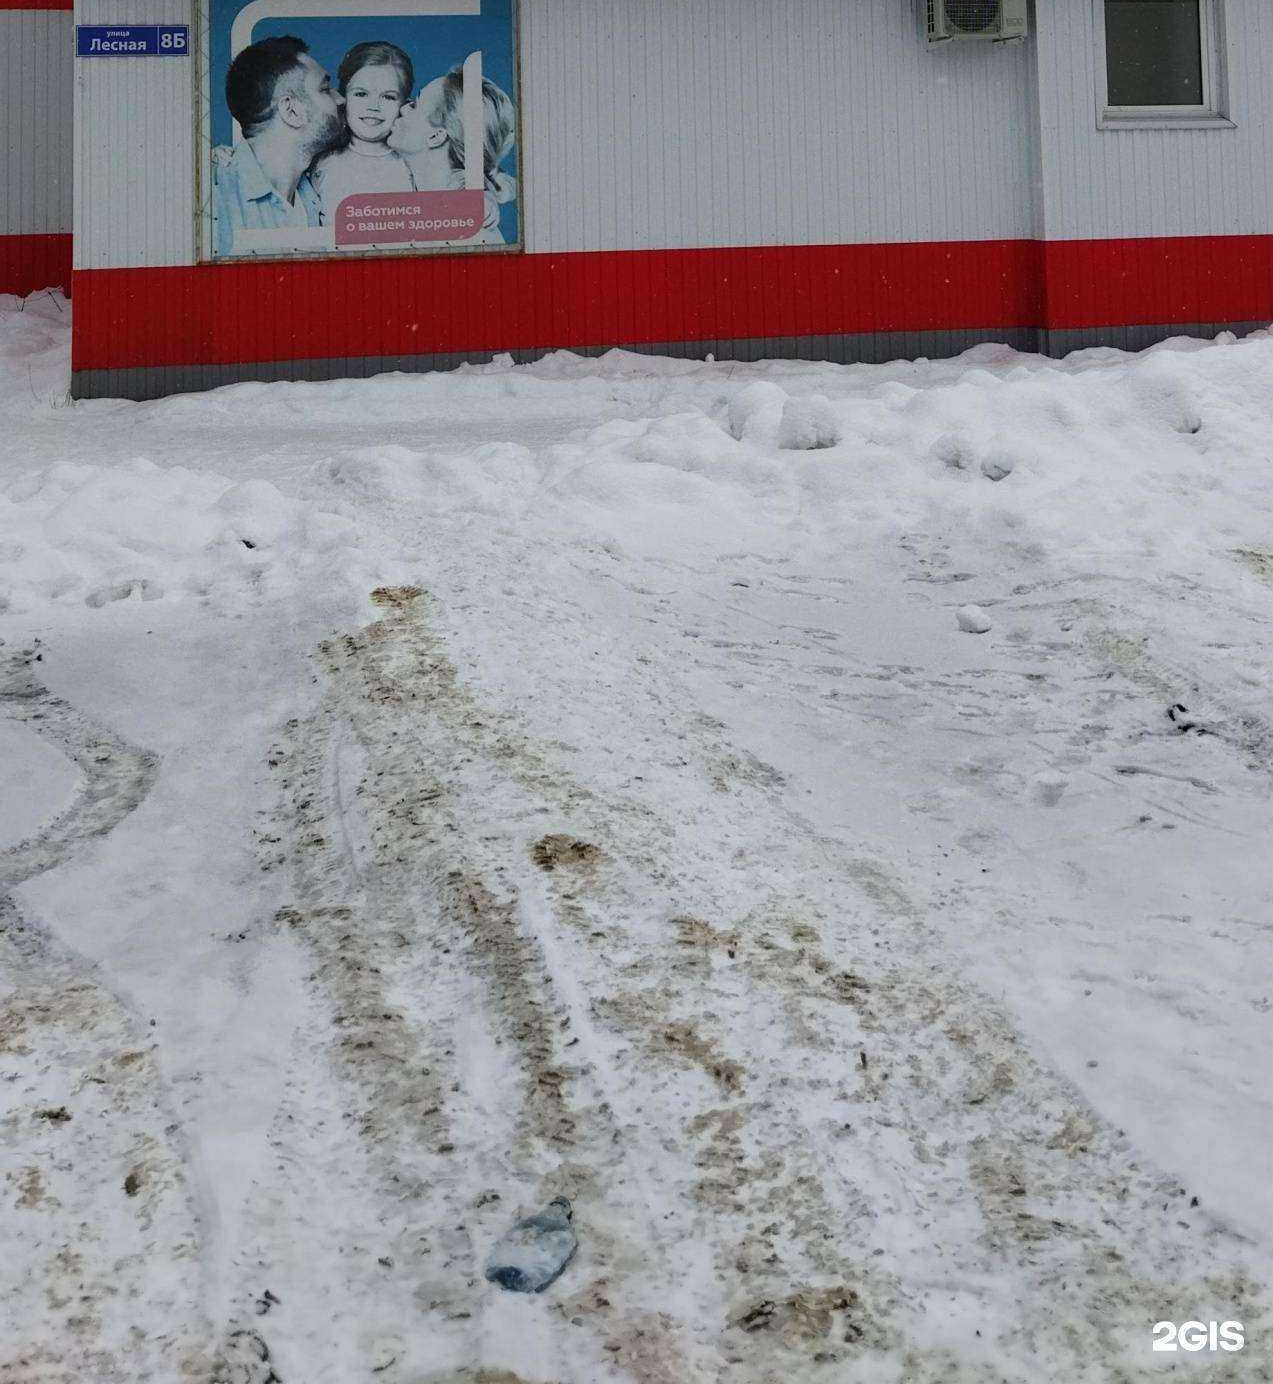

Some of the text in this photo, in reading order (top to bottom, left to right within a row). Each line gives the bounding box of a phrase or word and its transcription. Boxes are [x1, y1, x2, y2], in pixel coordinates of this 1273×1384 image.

[90, 33, 186, 51] Лесная 8Б
[345, 205, 422, 217] Заботимся
[346, 218, 475, 232] о вашем здоровье
